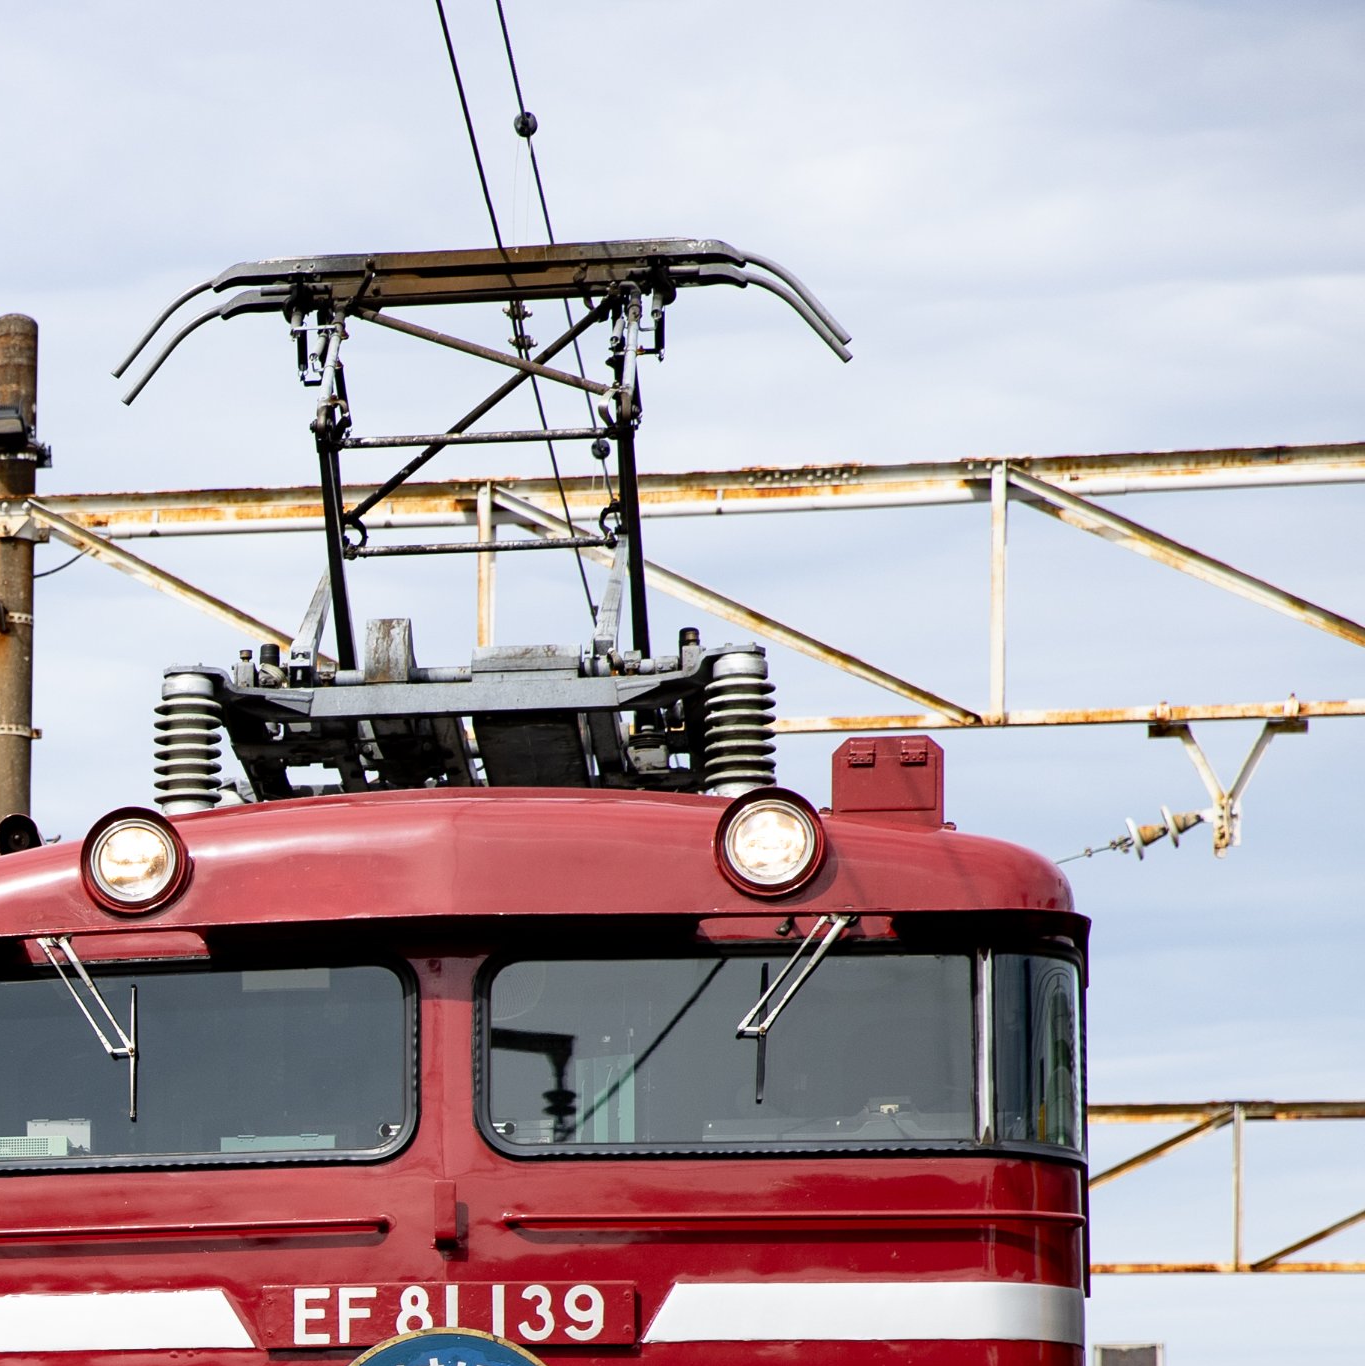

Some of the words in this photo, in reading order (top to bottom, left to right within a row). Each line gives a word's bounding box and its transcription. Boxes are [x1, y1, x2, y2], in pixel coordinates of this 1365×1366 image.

[293, 1286, 378, 1346] EF
[396, 1284, 459, 1336] 81
[491, 1284, 605, 1342] 139
